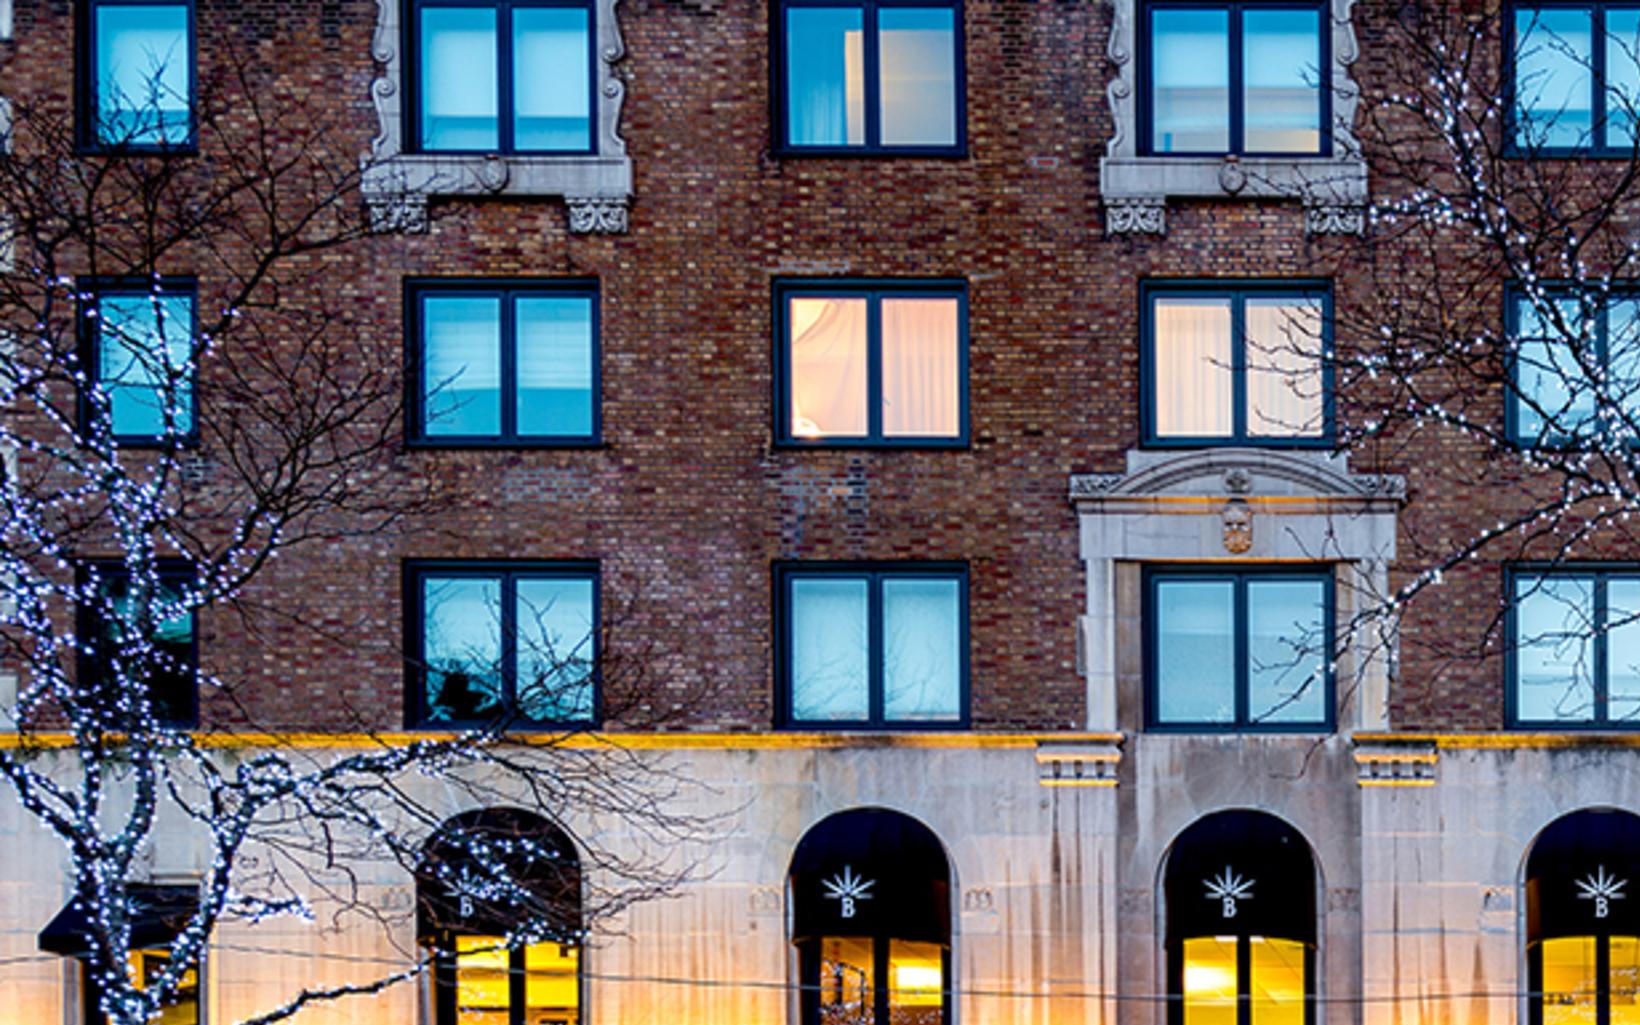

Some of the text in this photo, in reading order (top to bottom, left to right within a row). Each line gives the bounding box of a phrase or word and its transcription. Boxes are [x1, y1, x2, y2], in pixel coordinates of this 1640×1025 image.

[841, 897, 856, 918] B
[1222, 896, 1237, 918] B
[1595, 896, 1608, 918] B
